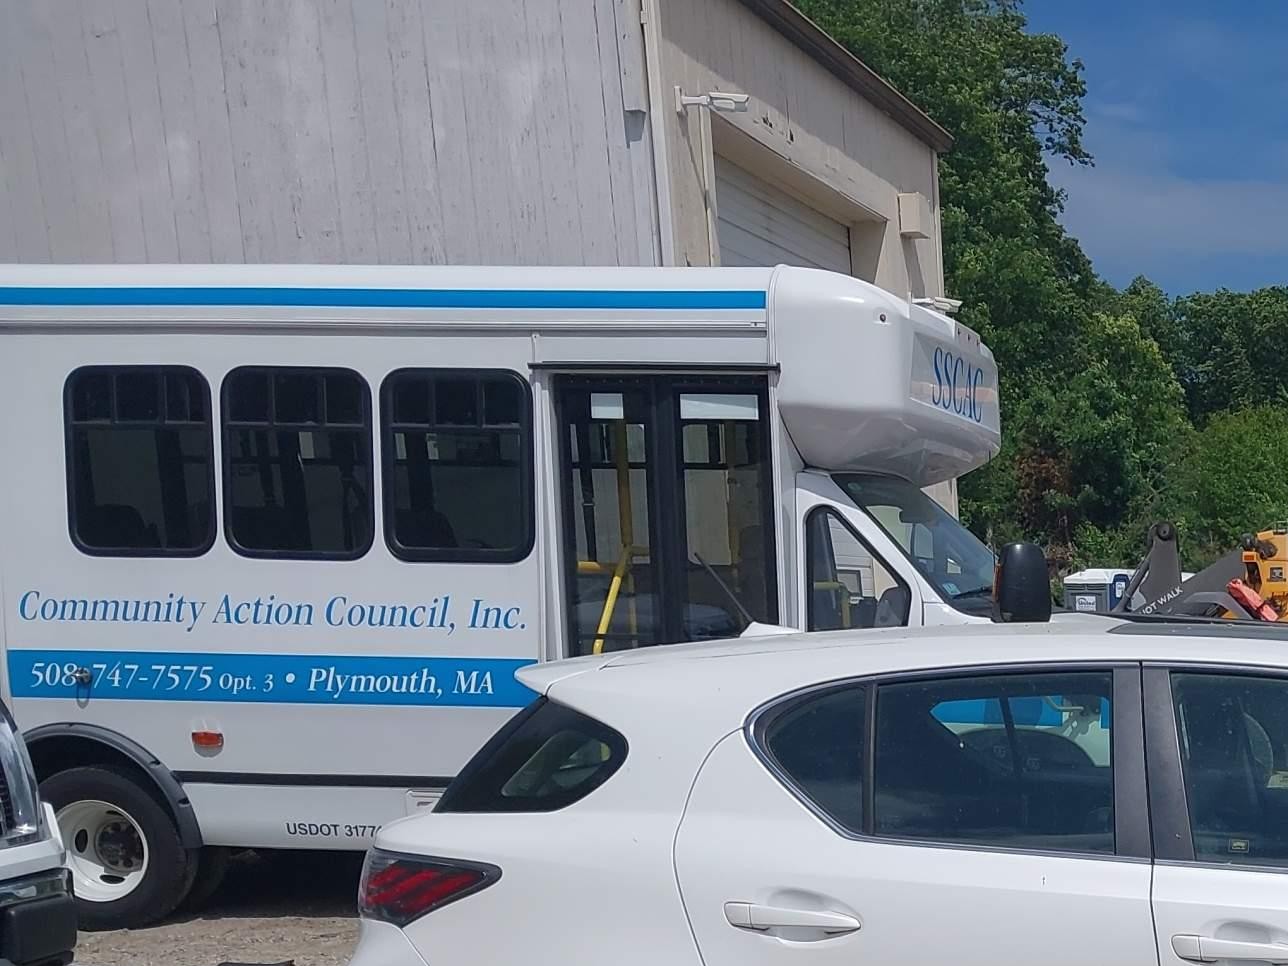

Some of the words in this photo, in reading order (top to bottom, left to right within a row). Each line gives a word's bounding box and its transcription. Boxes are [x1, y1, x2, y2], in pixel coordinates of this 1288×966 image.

[933, 347, 984, 423] SSCAC
[19, 590, 207, 632] Community
[212, 594, 314, 627] Action
[325, 595, 455, 636] Council,
[467, 599, 526, 630] Inc.
[1157, 586, 1184, 606] WALK
[31, 662, 214, 692] 508747-7575
[219, 673, 257, 695] Opt.
[263, 674, 274, 692] 3
[307, 666, 443, 699] Plymouth,
[452, 670, 495, 695] MA
[286, 822, 340, 837] USDOT
